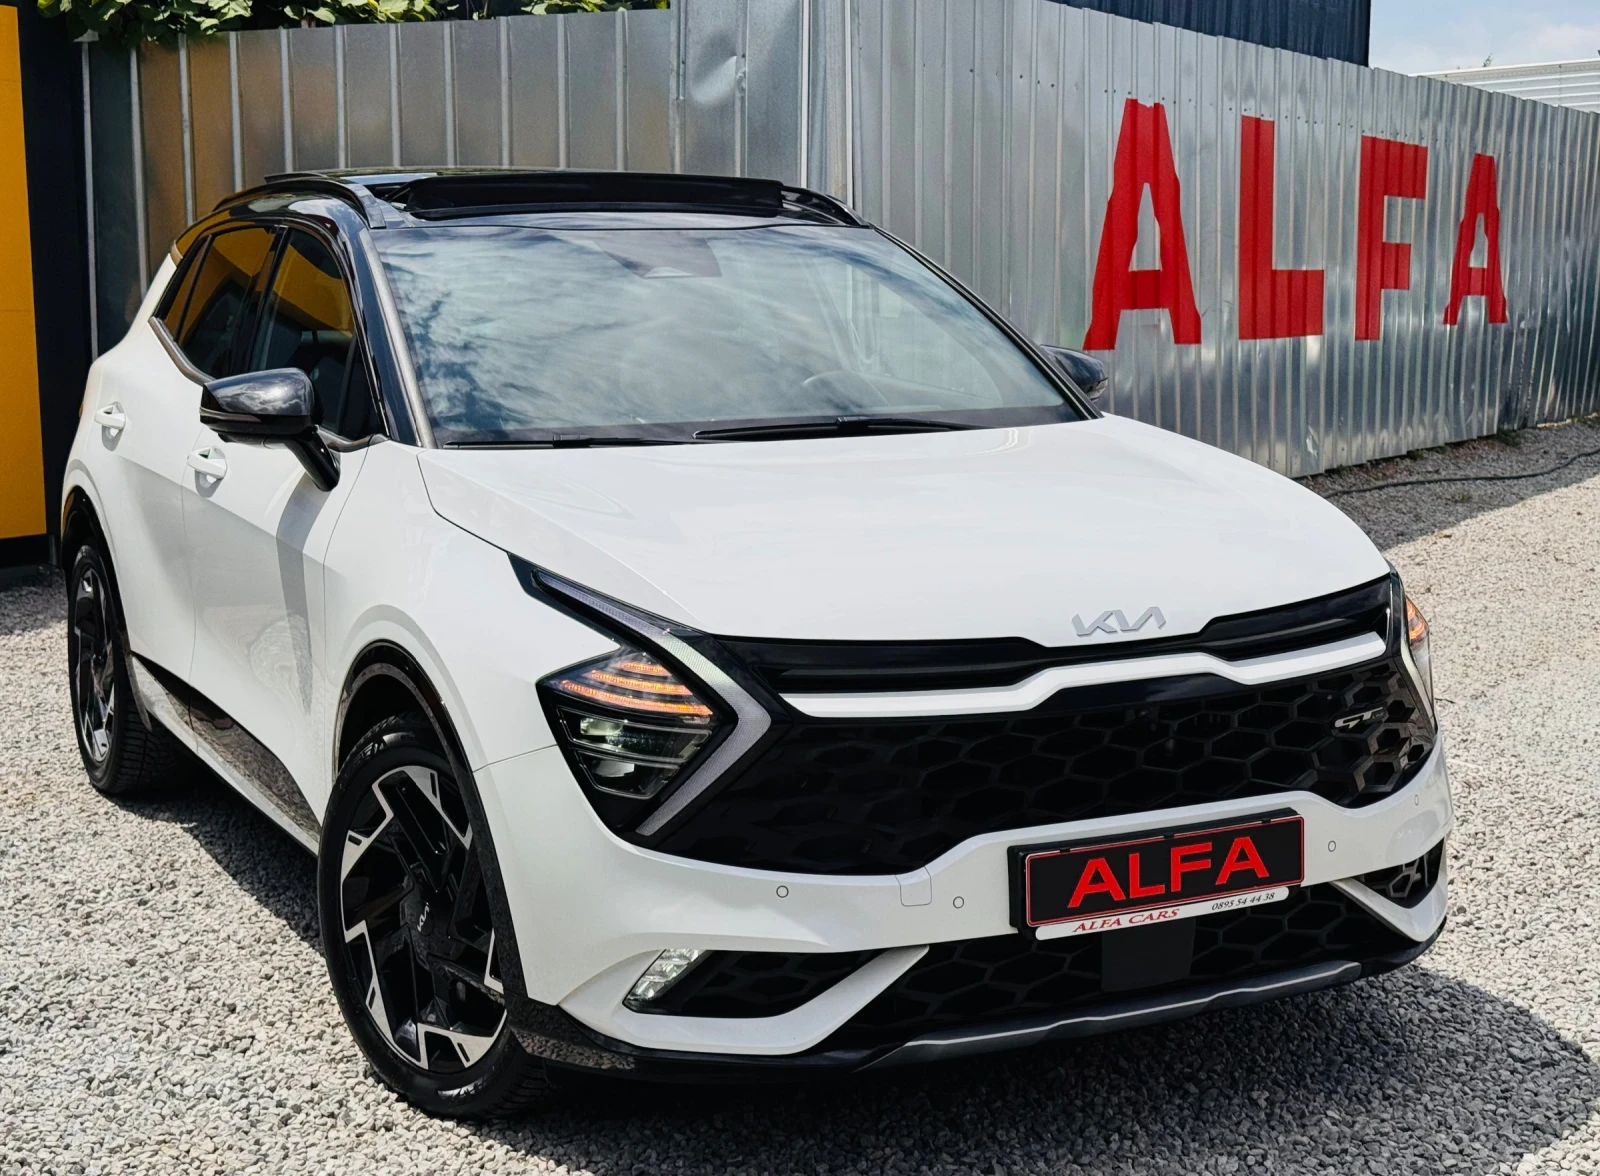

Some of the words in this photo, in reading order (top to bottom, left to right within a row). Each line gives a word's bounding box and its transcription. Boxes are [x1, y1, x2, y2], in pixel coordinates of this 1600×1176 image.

[1083, 98, 1508, 351] ALFA
[1067, 836, 1270, 908] ALFA
[1072, 917, 1122, 933] ALFA
[1128, 908, 1180, 924] CARS
[1211, 899, 1235, 911] 0895
[1235, 897, 1248, 907] 54
[1249, 894, 1262, 904] 44
[1263, 892, 1276, 901] 38
